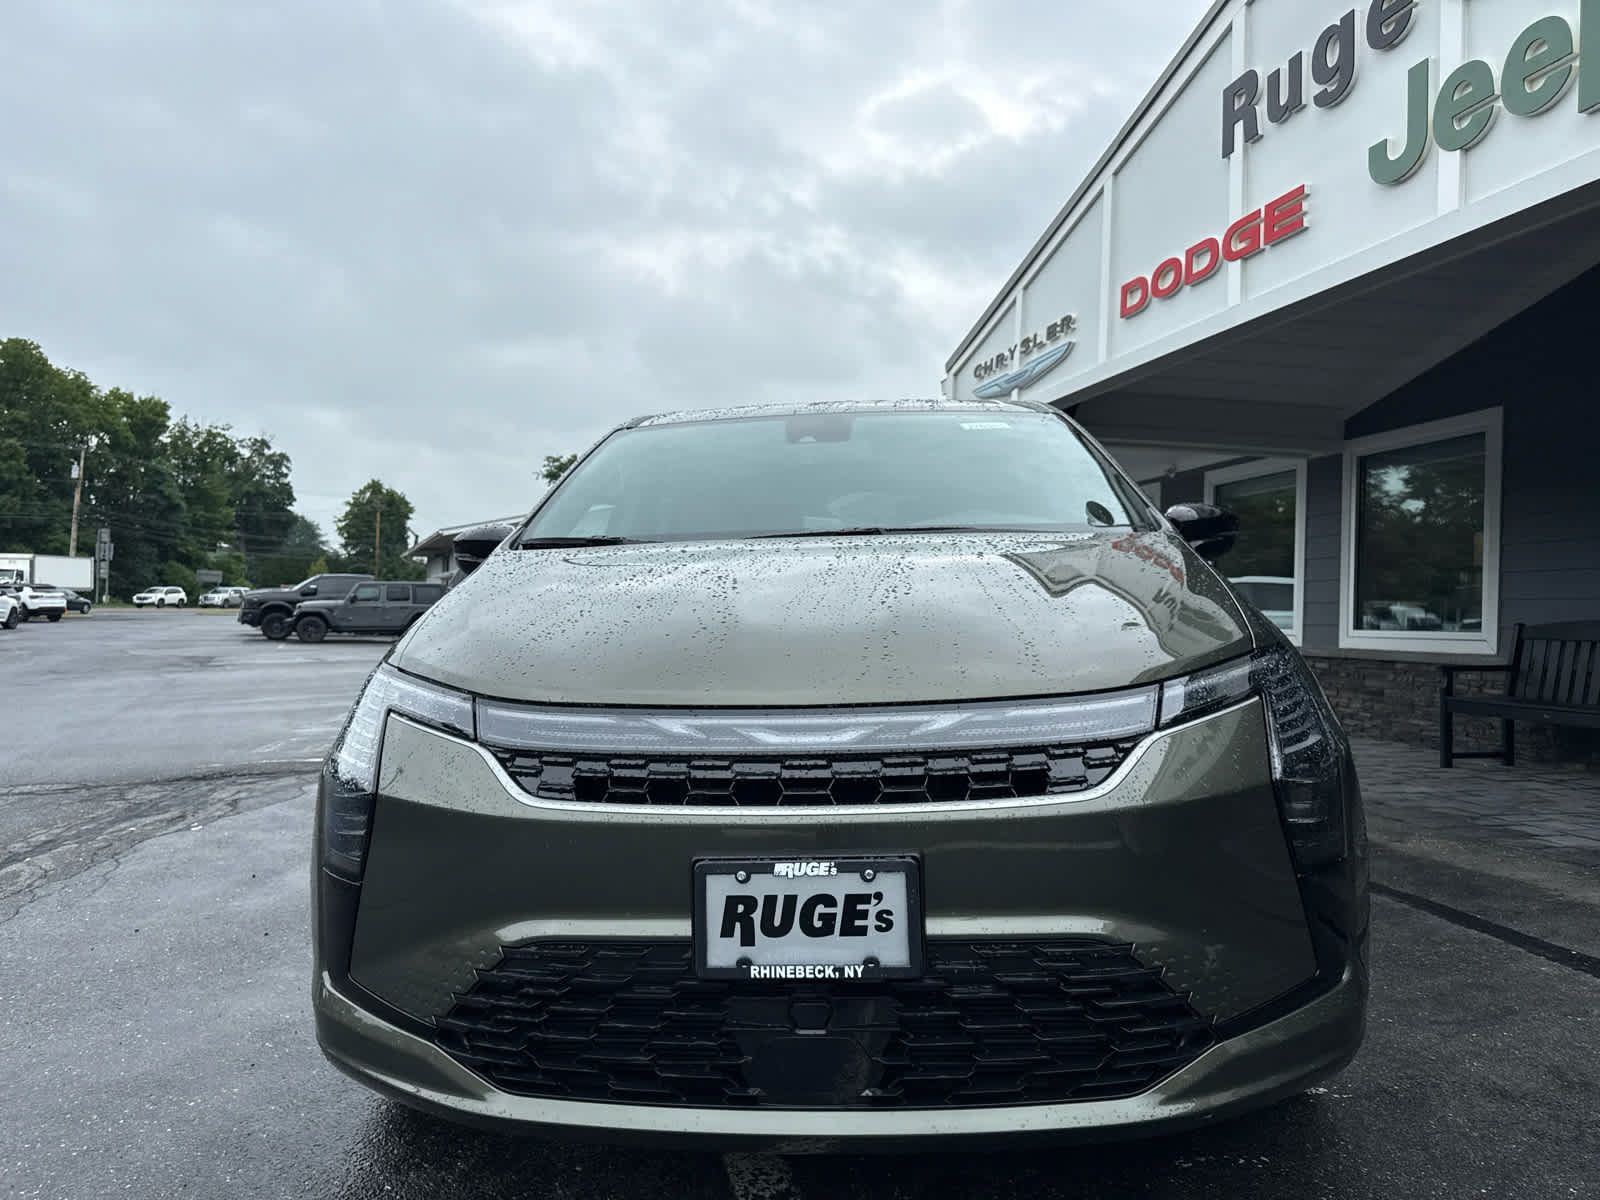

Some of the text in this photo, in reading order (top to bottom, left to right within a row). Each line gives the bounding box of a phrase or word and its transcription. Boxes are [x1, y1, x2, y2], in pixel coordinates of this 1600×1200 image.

[1367, 0, 1600, 185] Jee
[1119, 183, 1308, 319] DODGE
[973, 314, 1077, 380] CHRYSLER
[719, 891, 895, 948] RUGE's
[749, 964, 866, 980] RHINEBECK, NY
